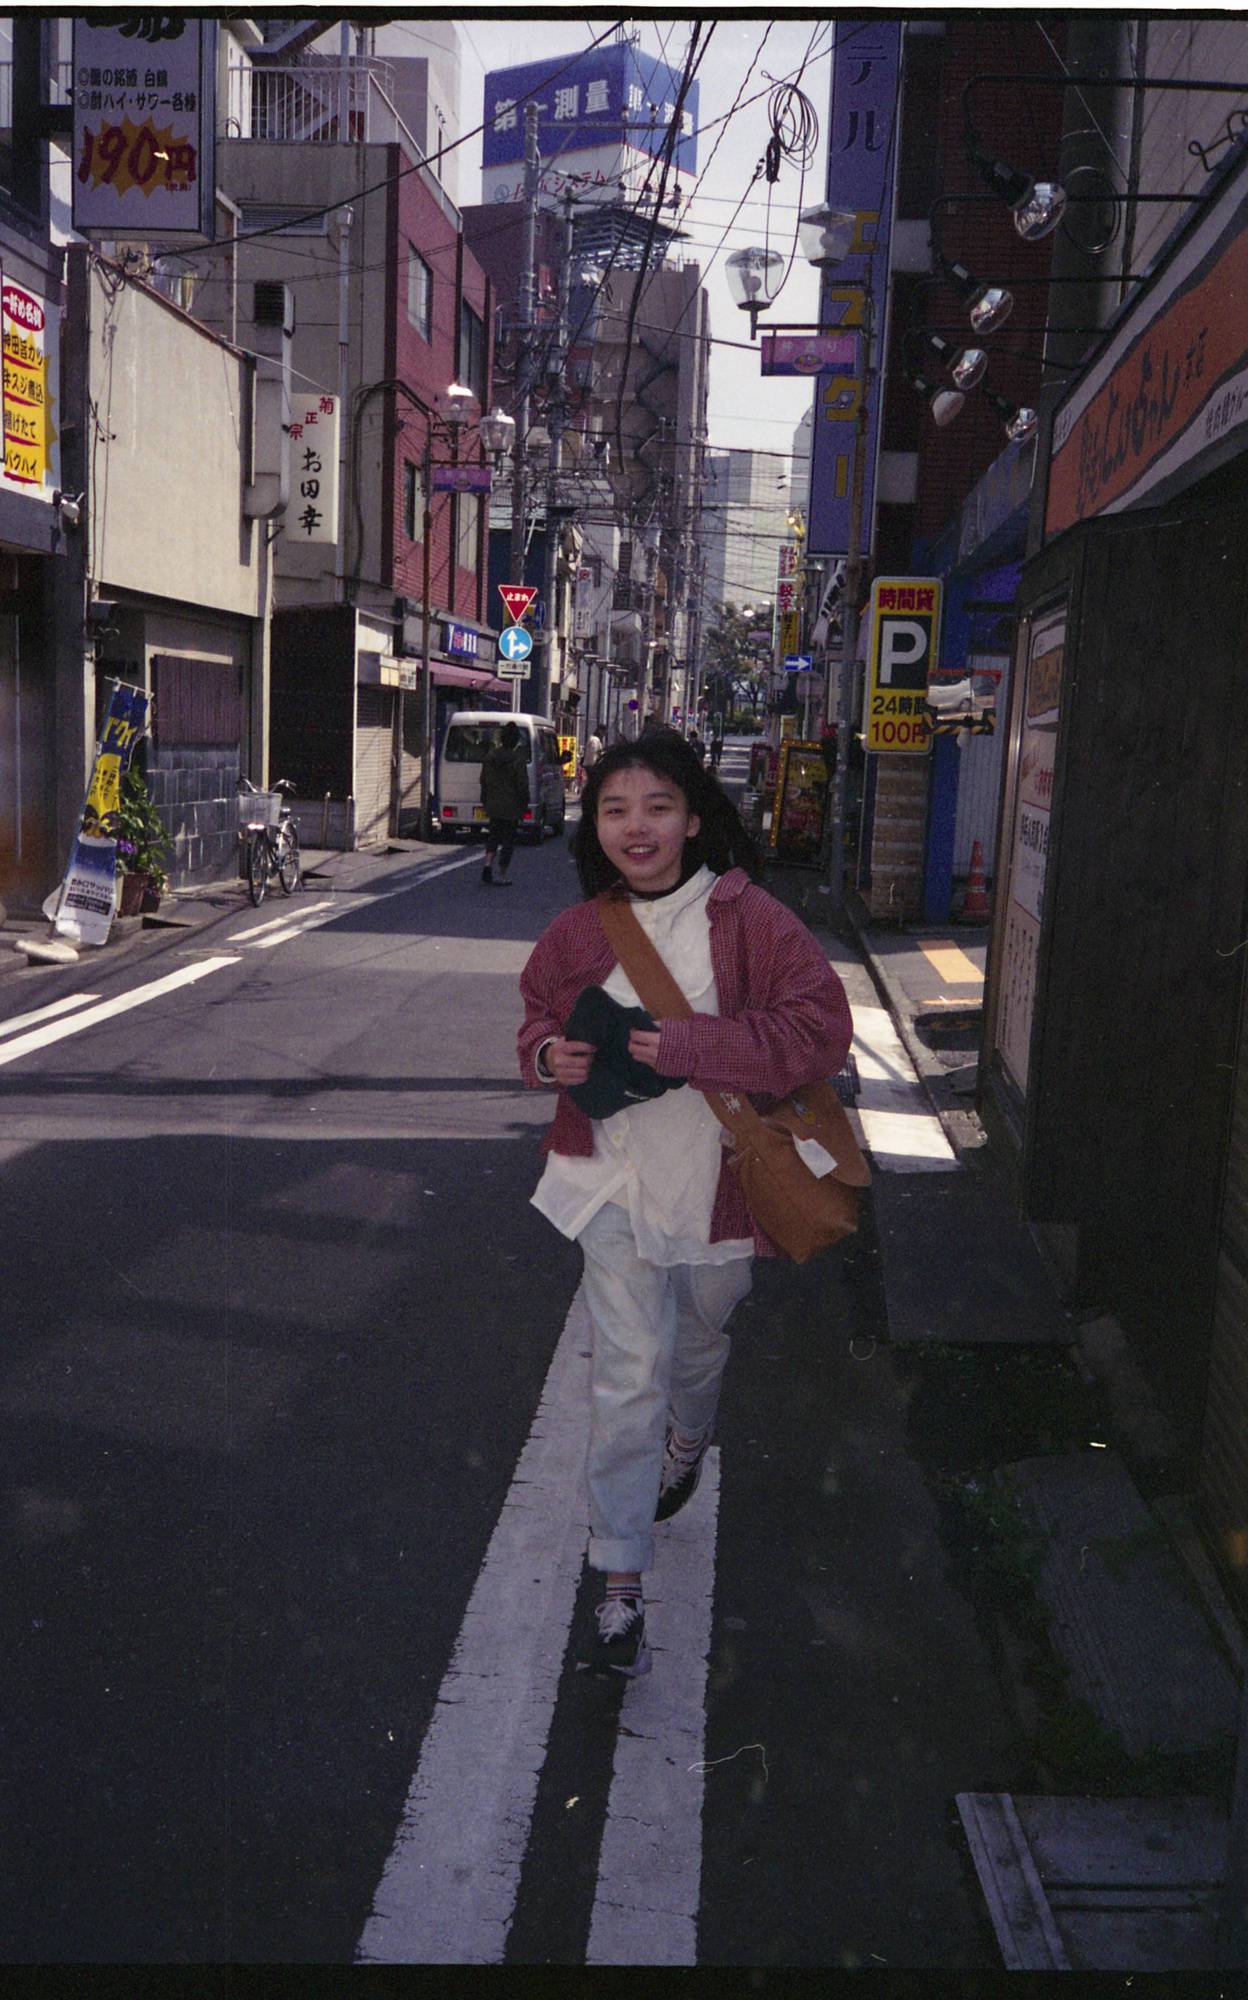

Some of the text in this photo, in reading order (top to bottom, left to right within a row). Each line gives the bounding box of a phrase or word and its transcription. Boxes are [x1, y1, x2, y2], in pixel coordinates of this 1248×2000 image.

[77, 125, 197, 185] 190円
[506, 591, 529, 602] 止まれ
[878, 587, 934, 611] 時間貸
[879, 620, 927, 684] P
[872, 721, 926, 744] 100円
